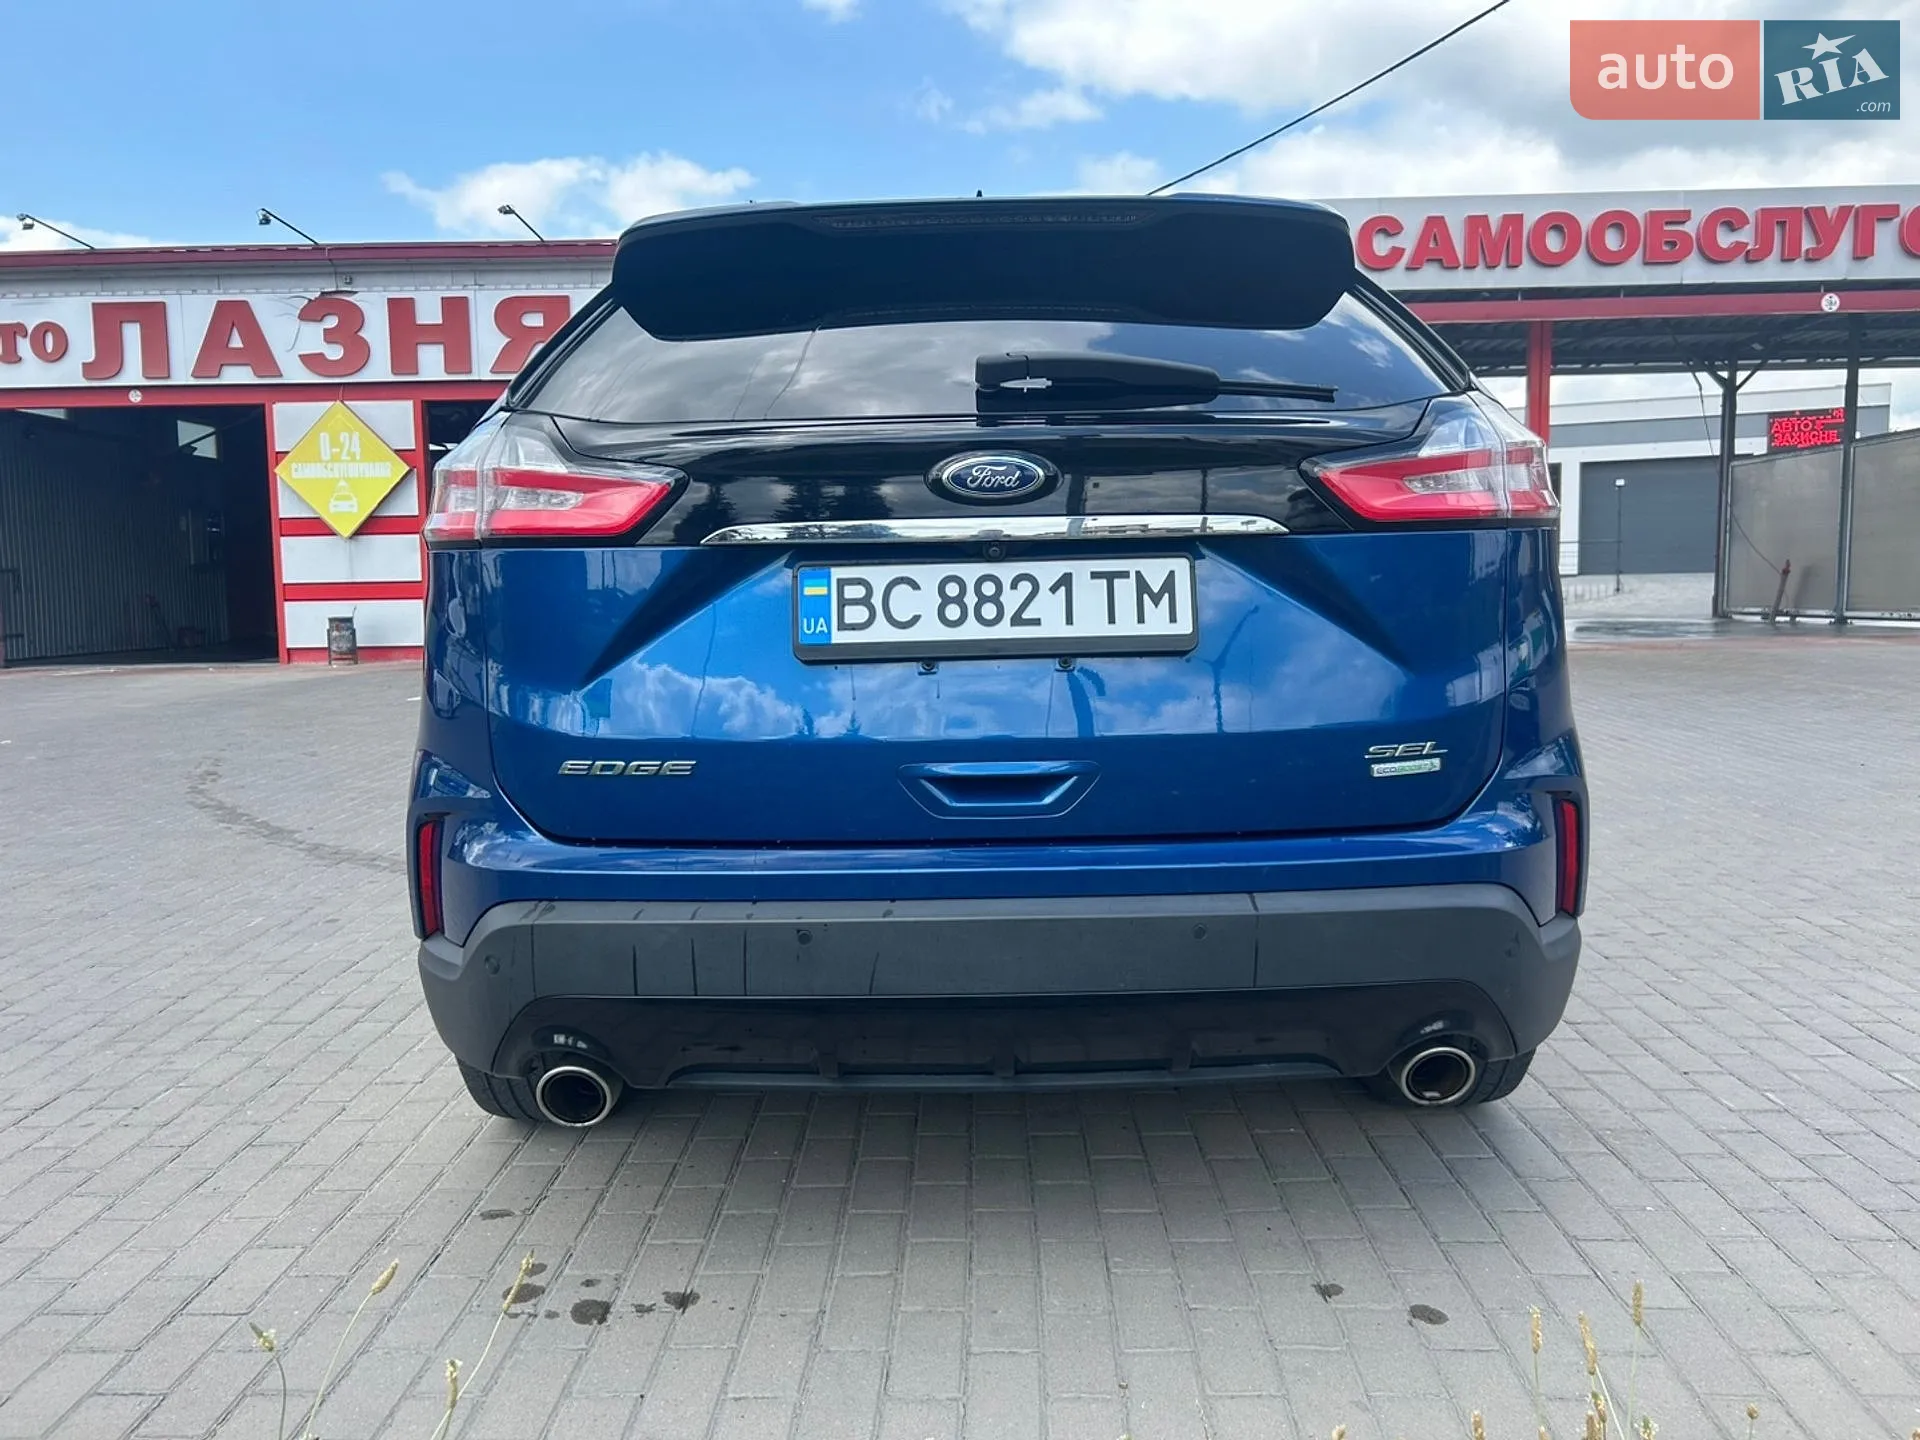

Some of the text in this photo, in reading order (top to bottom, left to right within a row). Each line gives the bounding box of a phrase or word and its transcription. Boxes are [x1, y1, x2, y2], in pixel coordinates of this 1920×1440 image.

[82, 291, 570, 379] ЛАЗНЯ
[966, 464, 1021, 490] Ford
[836, 570, 1178, 631] BC 8821 TM
[803, 616, 828, 635] UA
[1364, 741, 1448, 759] SEL
[557, 760, 697, 776] EDGE
